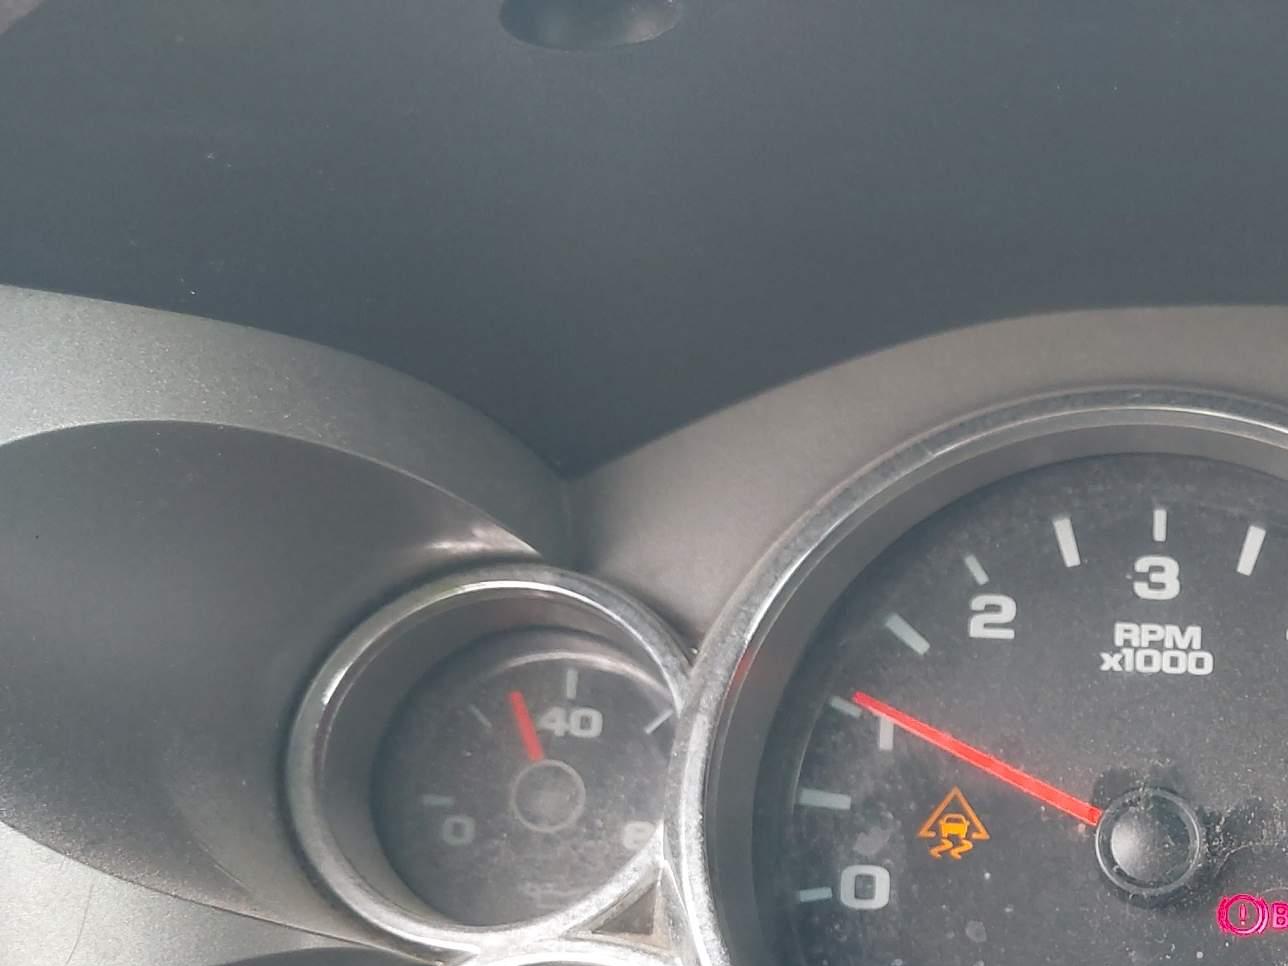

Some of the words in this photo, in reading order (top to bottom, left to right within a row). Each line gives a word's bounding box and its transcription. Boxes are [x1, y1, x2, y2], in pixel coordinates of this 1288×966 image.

[1134, 556, 1181, 600] 3
[968, 594, 1016, 640] 2
[1114, 622, 1202, 650] RPM
[1099, 649, 1213, 676] x1000
[536, 706, 603, 739] 40
[441, 815, 476, 846] 0
[840, 865, 892, 911] 0
